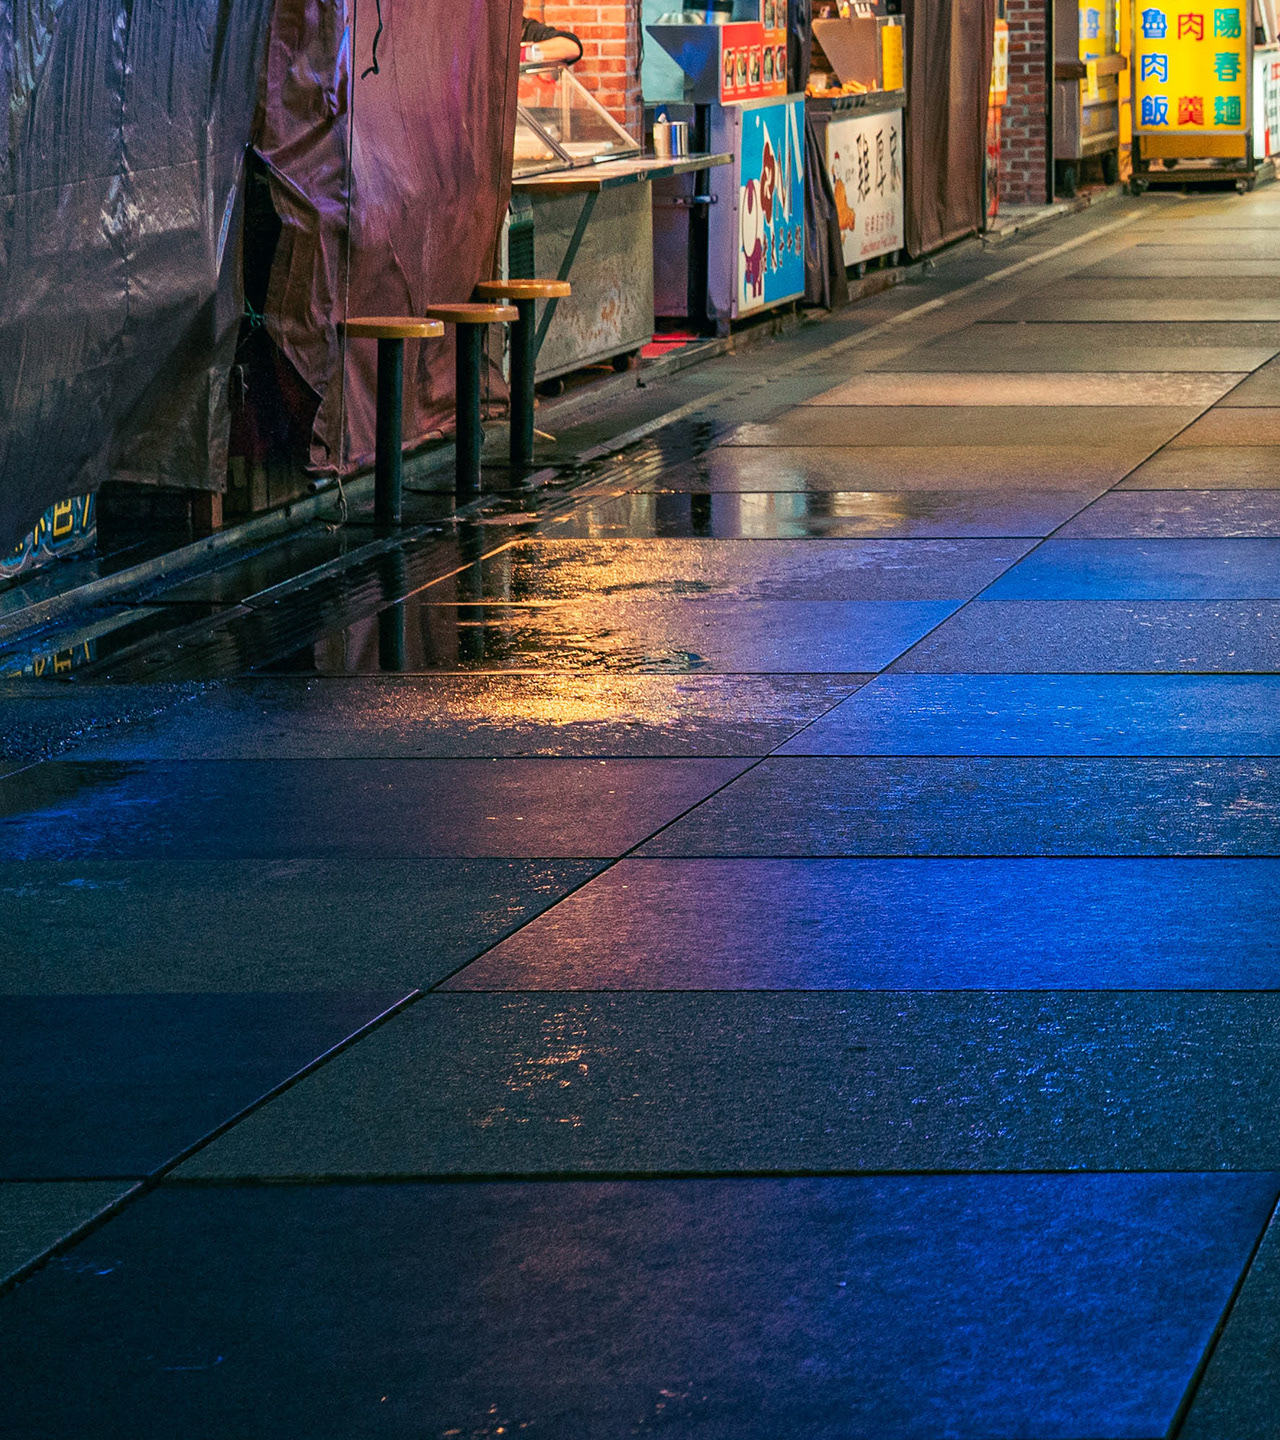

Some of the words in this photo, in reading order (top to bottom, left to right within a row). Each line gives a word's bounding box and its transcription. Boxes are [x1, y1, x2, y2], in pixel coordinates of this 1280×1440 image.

[1140, 7, 1169, 127] 魯肉飯
[1177, 12, 1205, 126] 肉羹
[1213, 7, 1242, 127] 陽春麵
